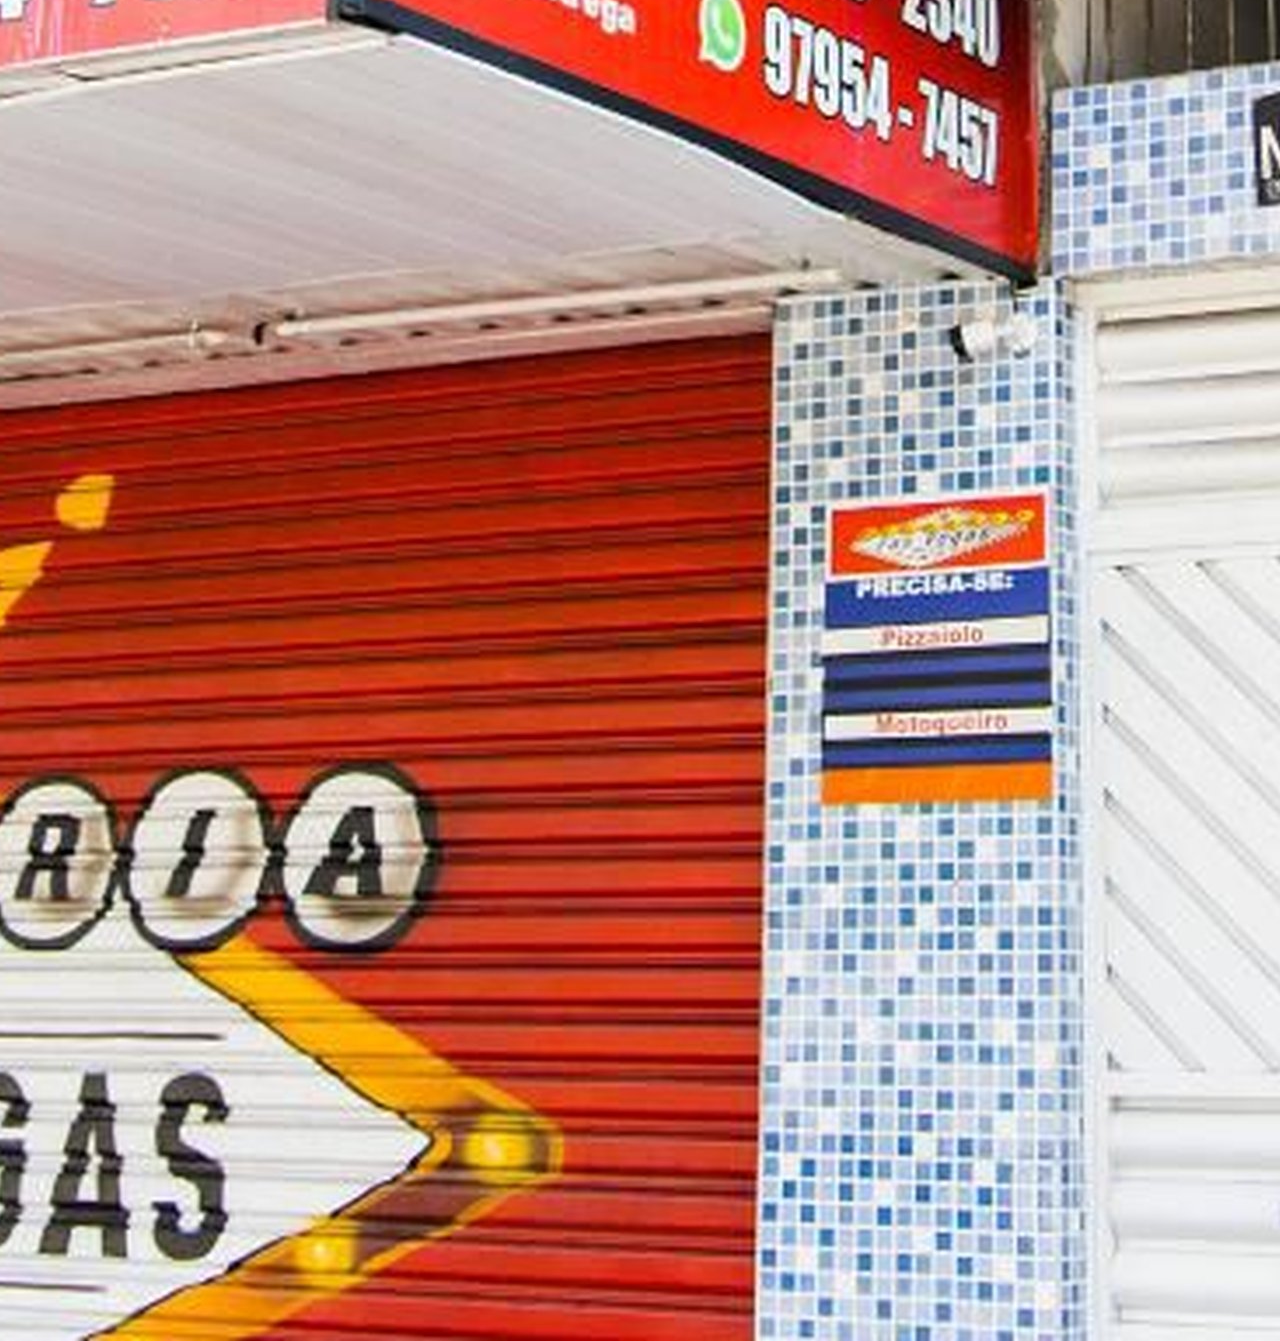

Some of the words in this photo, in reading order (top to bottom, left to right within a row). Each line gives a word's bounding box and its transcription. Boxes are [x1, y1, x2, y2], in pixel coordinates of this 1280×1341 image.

[763, 5, 892, 142] 97954
[917, 78, 997, 187] 7457
[879, 624, 985, 648] Pizzaiolo
[875, 710, 1009, 736] Motoqueiro
